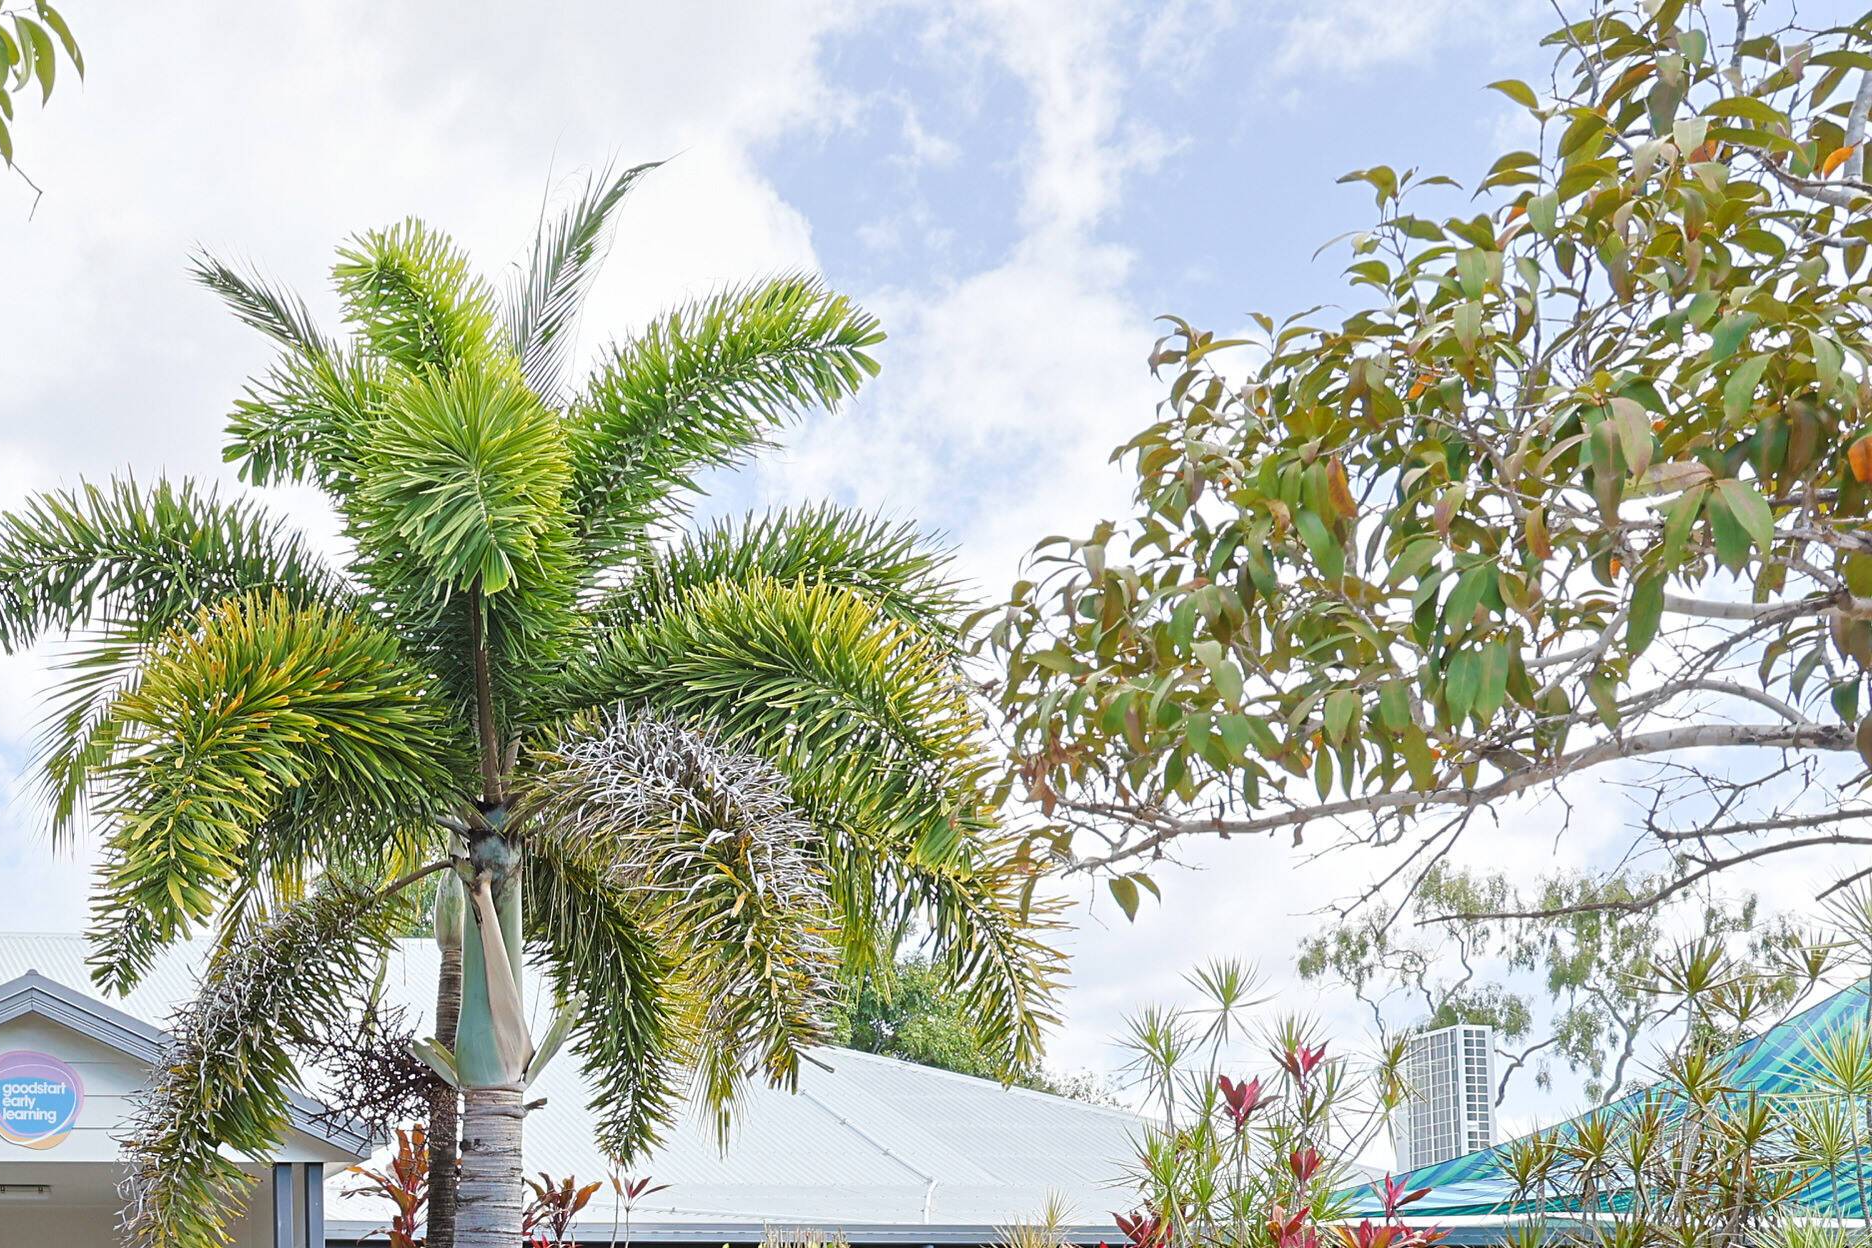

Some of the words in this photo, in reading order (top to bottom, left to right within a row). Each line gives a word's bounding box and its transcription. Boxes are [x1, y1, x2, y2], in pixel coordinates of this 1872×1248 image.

[2, 1082, 66, 1097] goodstart
[2, 1095, 36, 1109] early
[2, 1108, 56, 1123] learning
